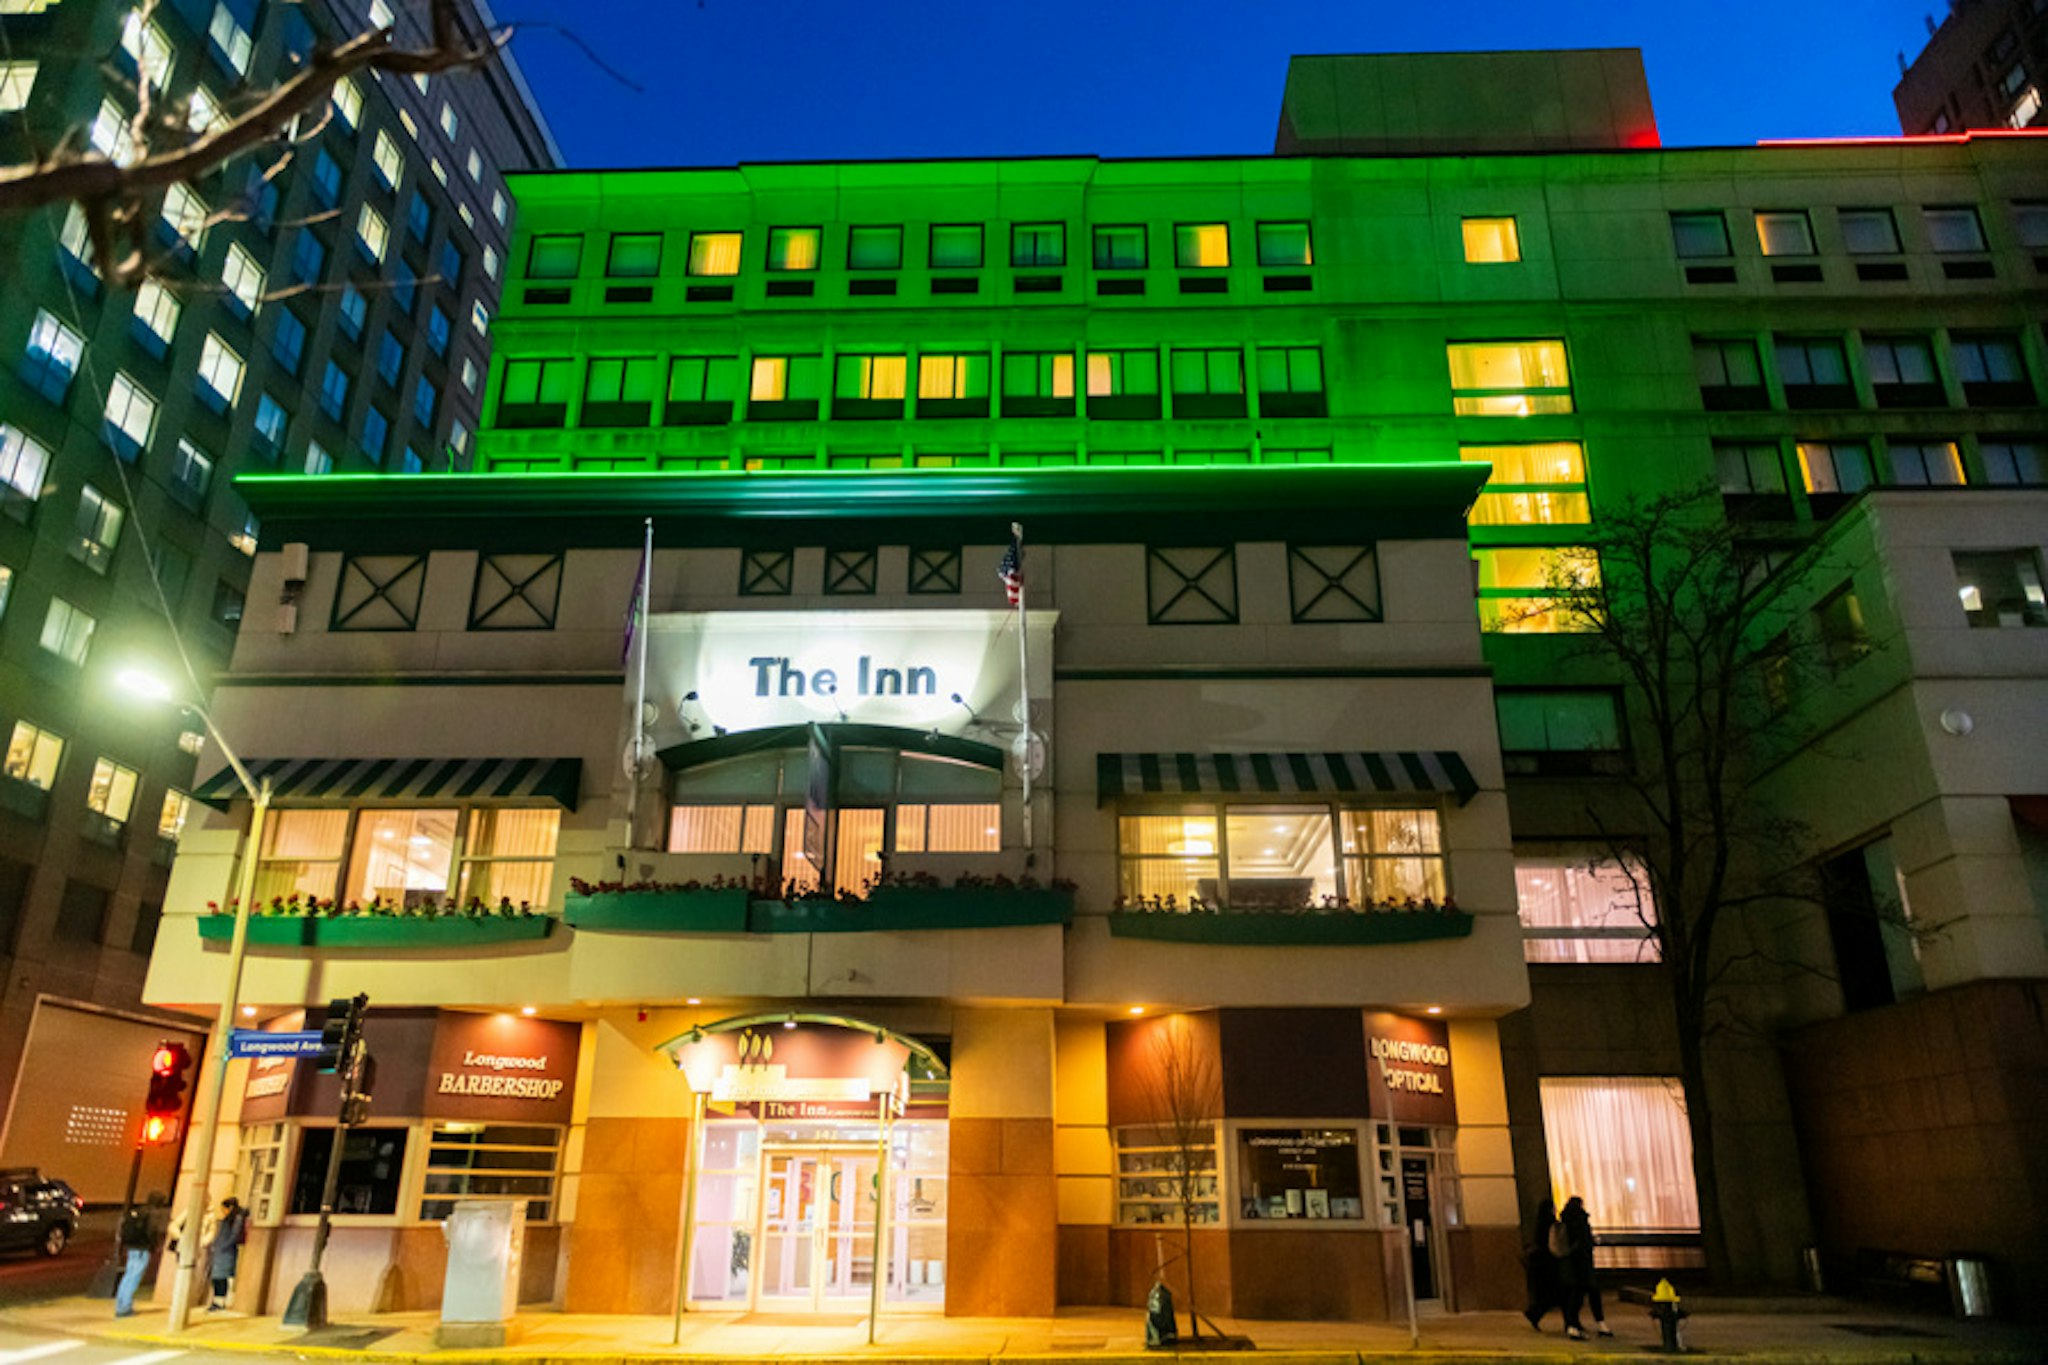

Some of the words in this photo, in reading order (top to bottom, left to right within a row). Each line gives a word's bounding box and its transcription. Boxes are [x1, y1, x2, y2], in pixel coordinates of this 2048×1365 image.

[749, 656, 837, 696] The
[858, 655, 936, 696] Inn
[240, 1041, 300, 1054] Longwood
[1371, 1037, 1449, 1066] LONGWOOD
[463, 1050, 548, 1071] Longwood
[438, 1073, 563, 1099] BARBERSHOP
[768, 1103, 795, 1116] The
